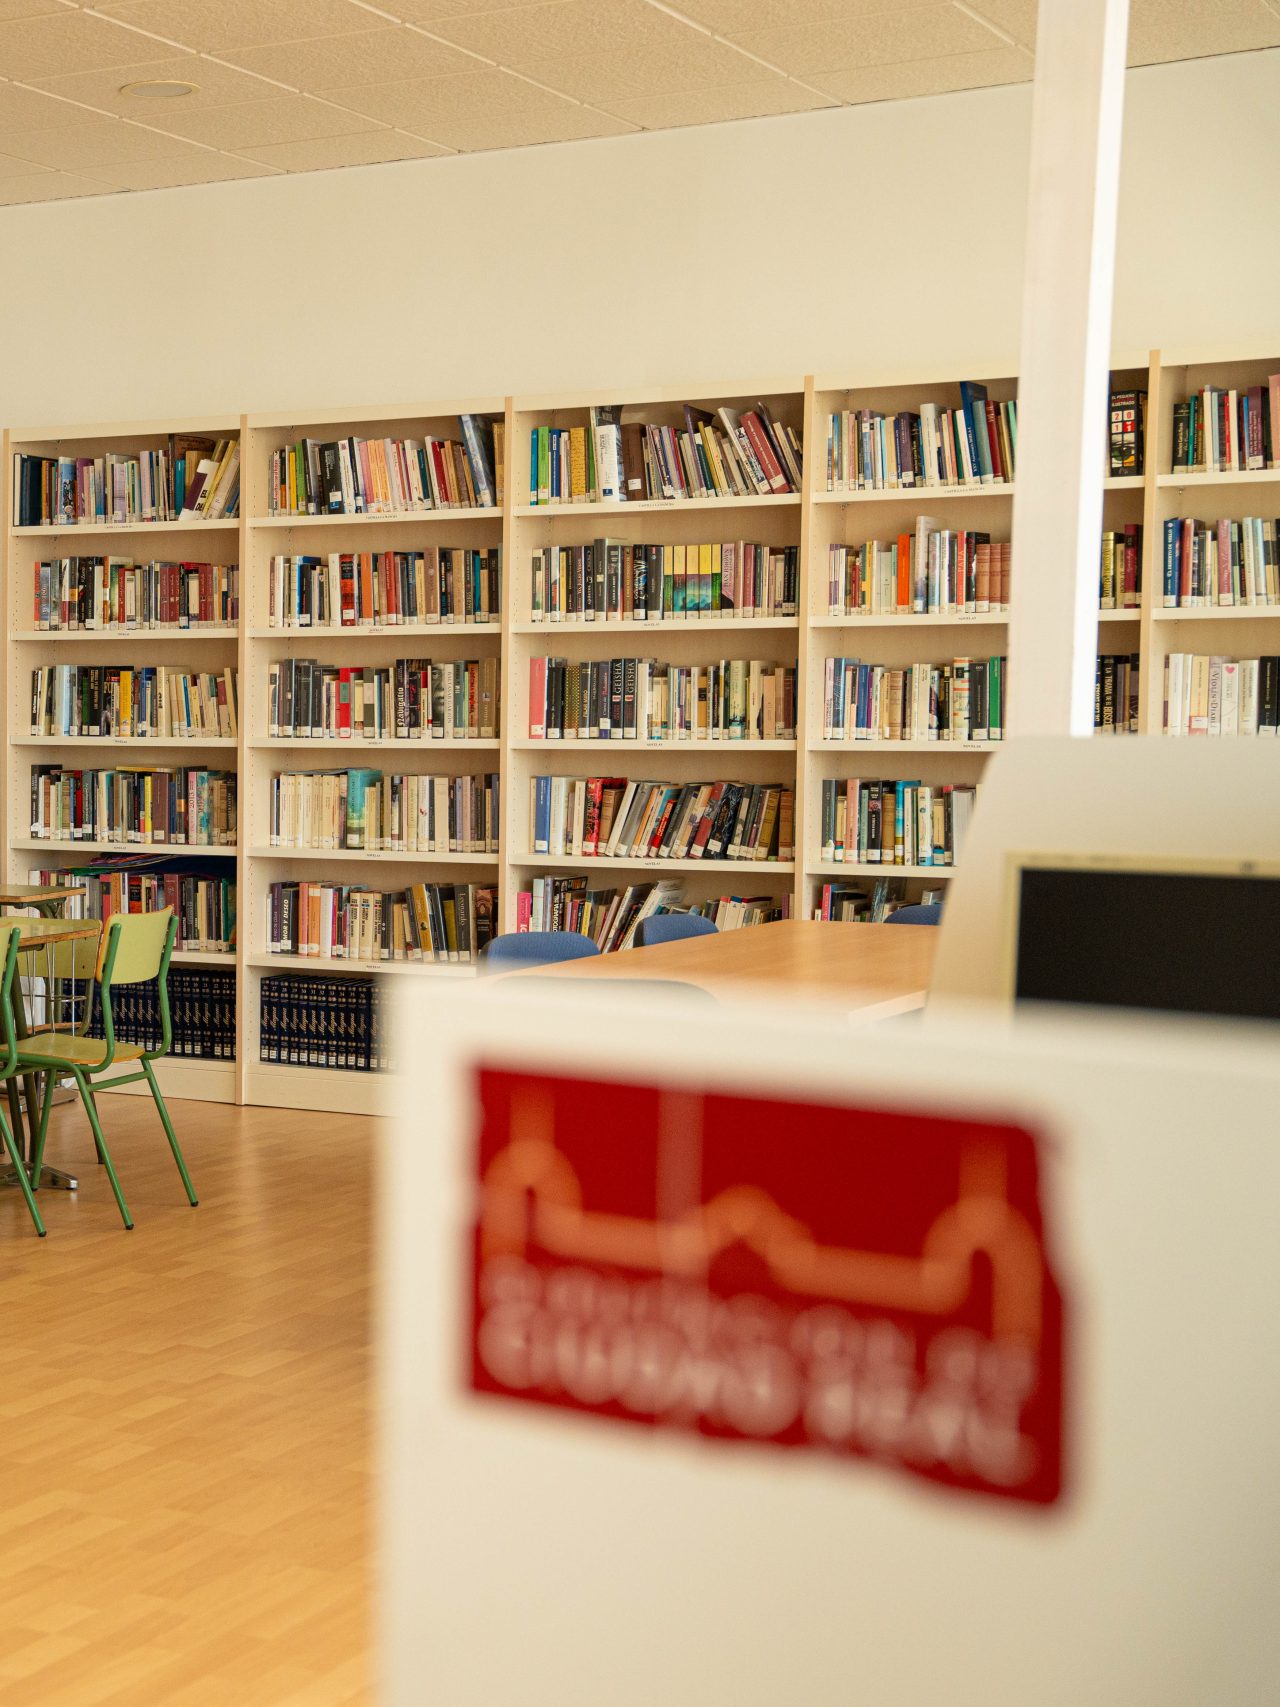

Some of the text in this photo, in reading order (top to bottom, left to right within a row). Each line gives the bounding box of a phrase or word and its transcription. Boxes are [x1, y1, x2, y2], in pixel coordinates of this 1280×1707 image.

[1114, 412, 1120, 421] 2
[613, 661, 622, 694] GEISHA
[626, 661, 635, 693] GEISHA
[1104, 675, 1112, 695] TRAMA
[396, 687, 405, 726] Navigatio
[1103, 706, 1112, 726] BOSCO
